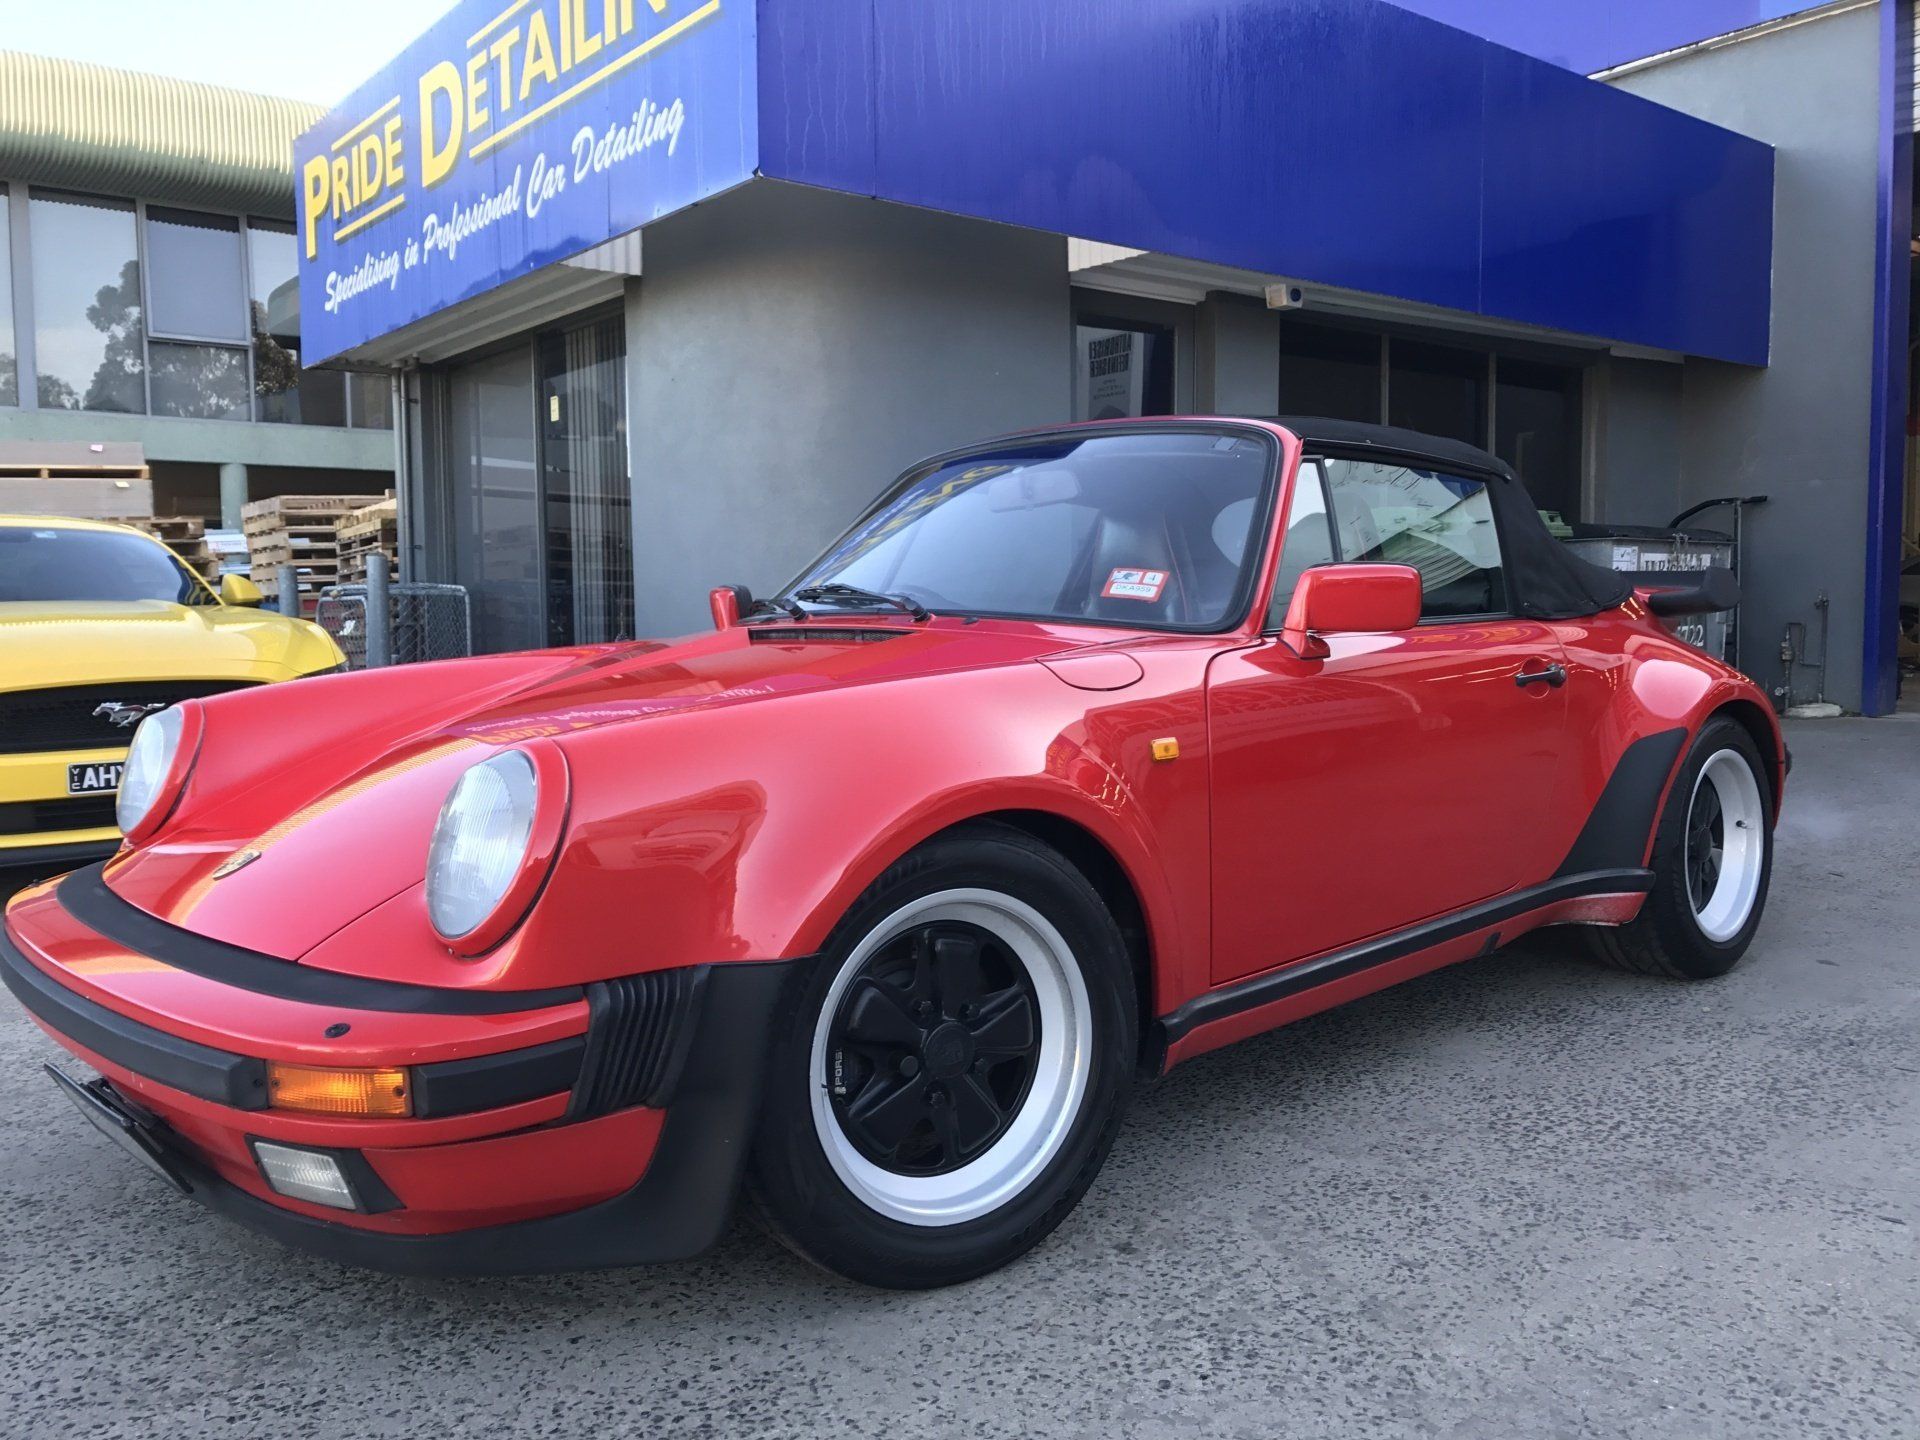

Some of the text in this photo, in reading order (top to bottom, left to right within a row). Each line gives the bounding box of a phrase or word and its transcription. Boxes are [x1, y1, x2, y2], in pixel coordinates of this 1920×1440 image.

[303, 114, 404, 259] PRIDE
[325, 97, 685, 314] Specialising in Professional Car Detailing
[1676, 624, 1704, 647] 722
[71, 768, 80, 790] VIC
[834, 1049, 843, 1086] PORS
